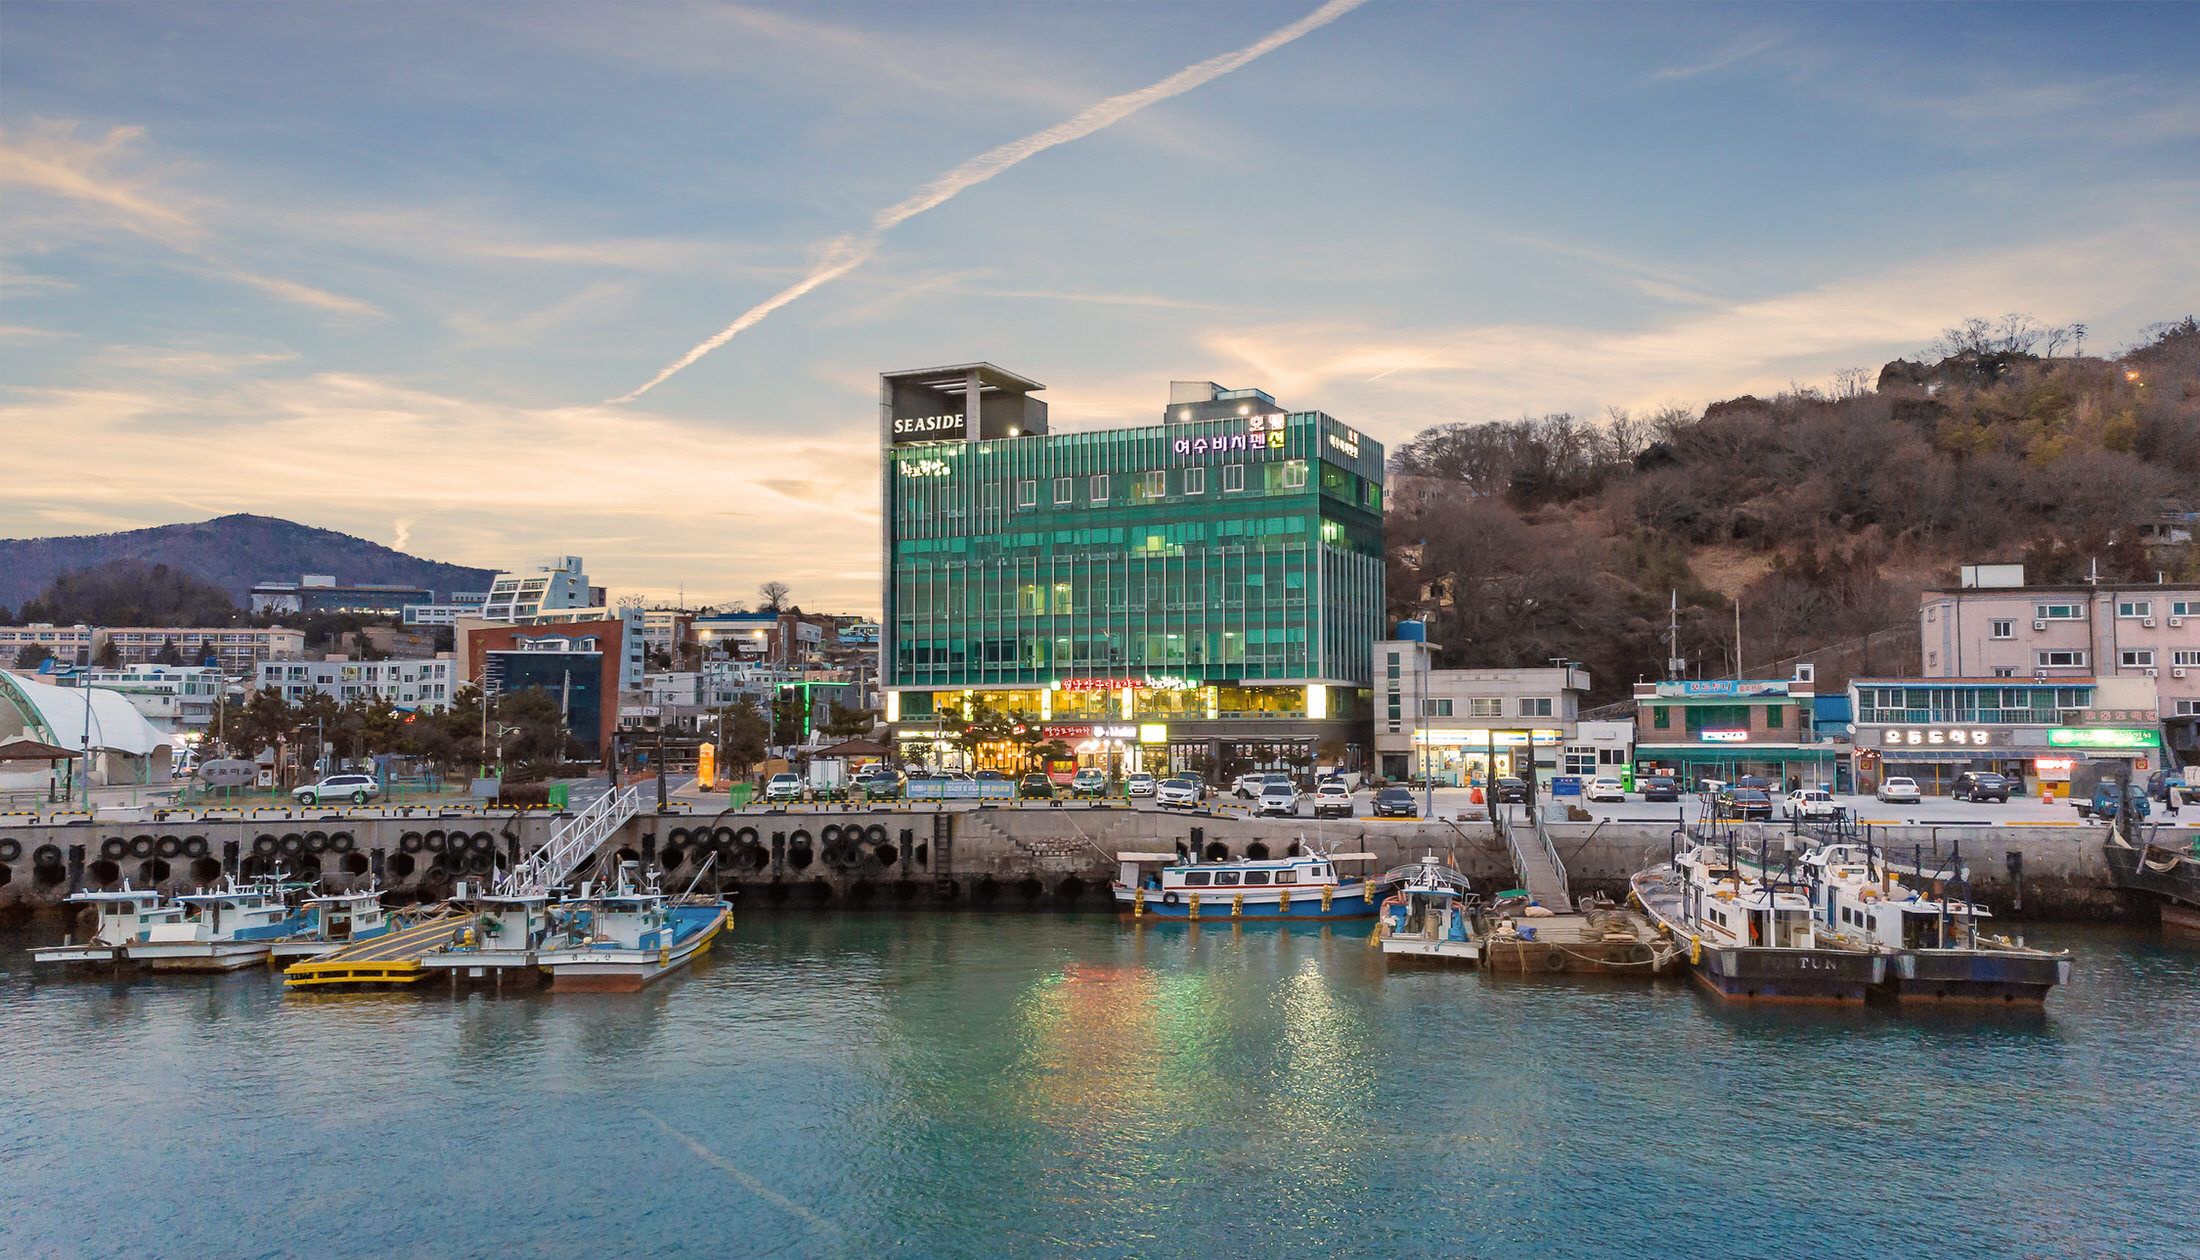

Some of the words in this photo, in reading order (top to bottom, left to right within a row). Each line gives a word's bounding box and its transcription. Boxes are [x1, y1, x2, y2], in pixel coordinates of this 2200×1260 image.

[894, 414, 964, 433] SEASIDE
[1175, 431, 1284, 455] 여수비치펜션
[1885, 729, 1988, 744] 오동도식당
